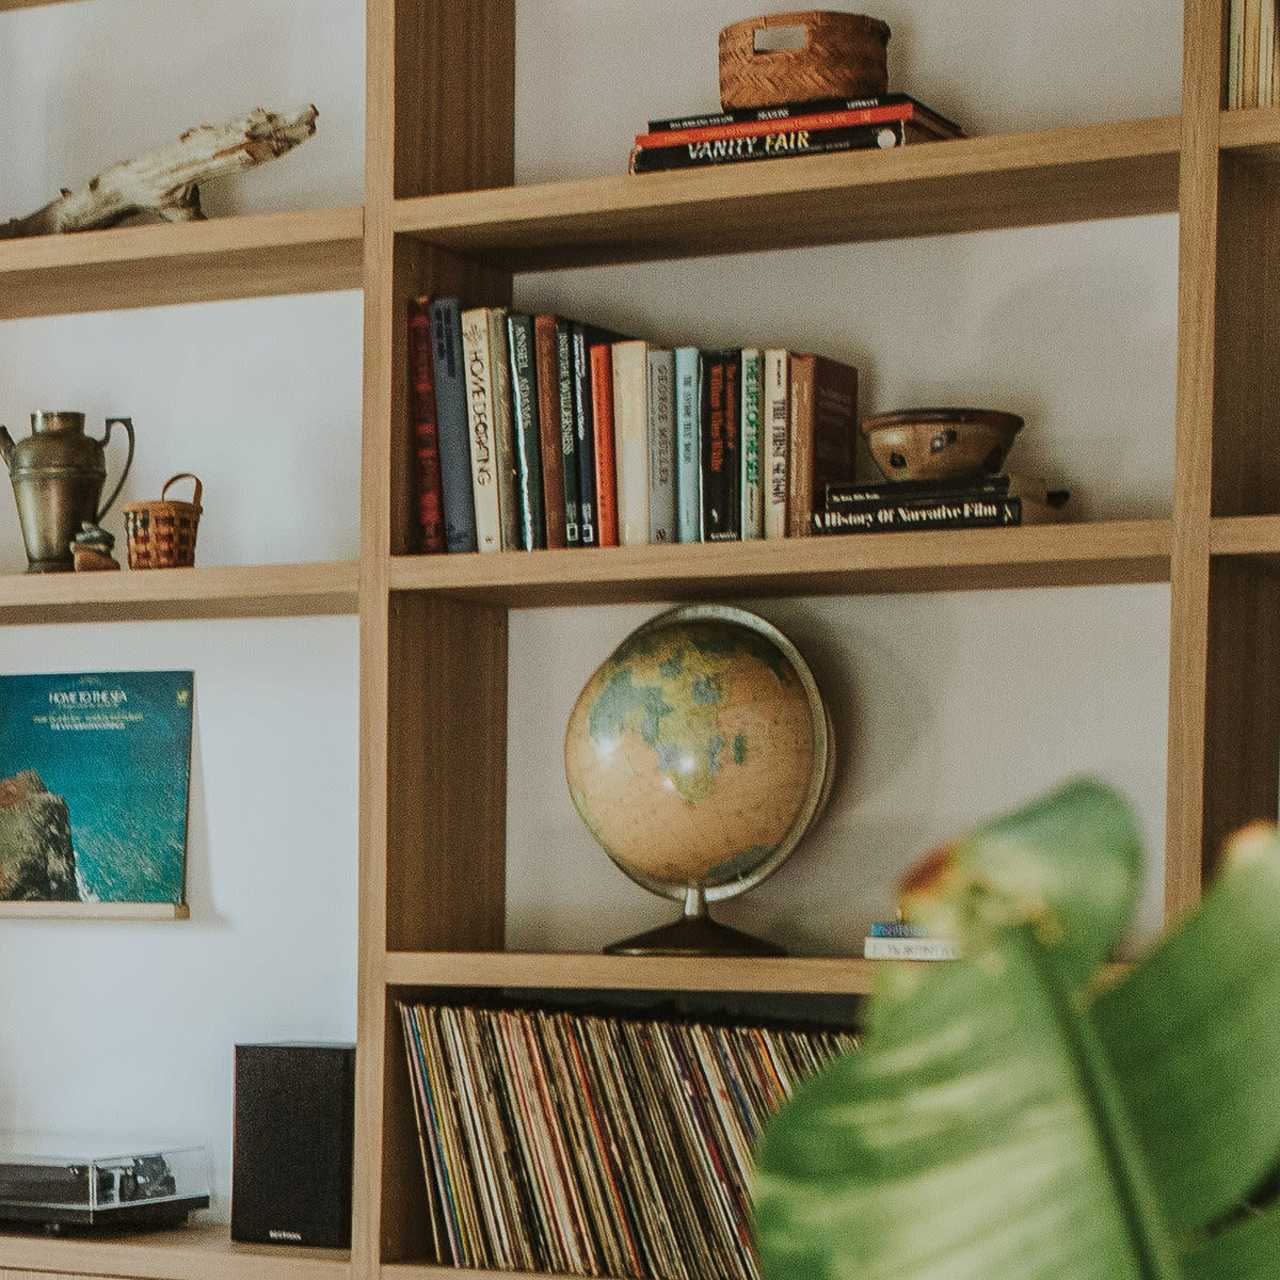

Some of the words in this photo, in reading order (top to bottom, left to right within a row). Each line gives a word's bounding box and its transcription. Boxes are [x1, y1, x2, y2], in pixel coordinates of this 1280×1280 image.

[687, 136, 757, 161] VANITY
[765, 130, 810, 153] FAIR
[515, 324, 529, 374] ANSEL
[657, 365, 670, 423] GEORGE
[814, 513, 823, 529] A
[825, 511, 873, 528] History
[877, 509, 896, 524] Of
[897, 505, 962, 522] Narrative
[963, 502, 998, 520] Film
